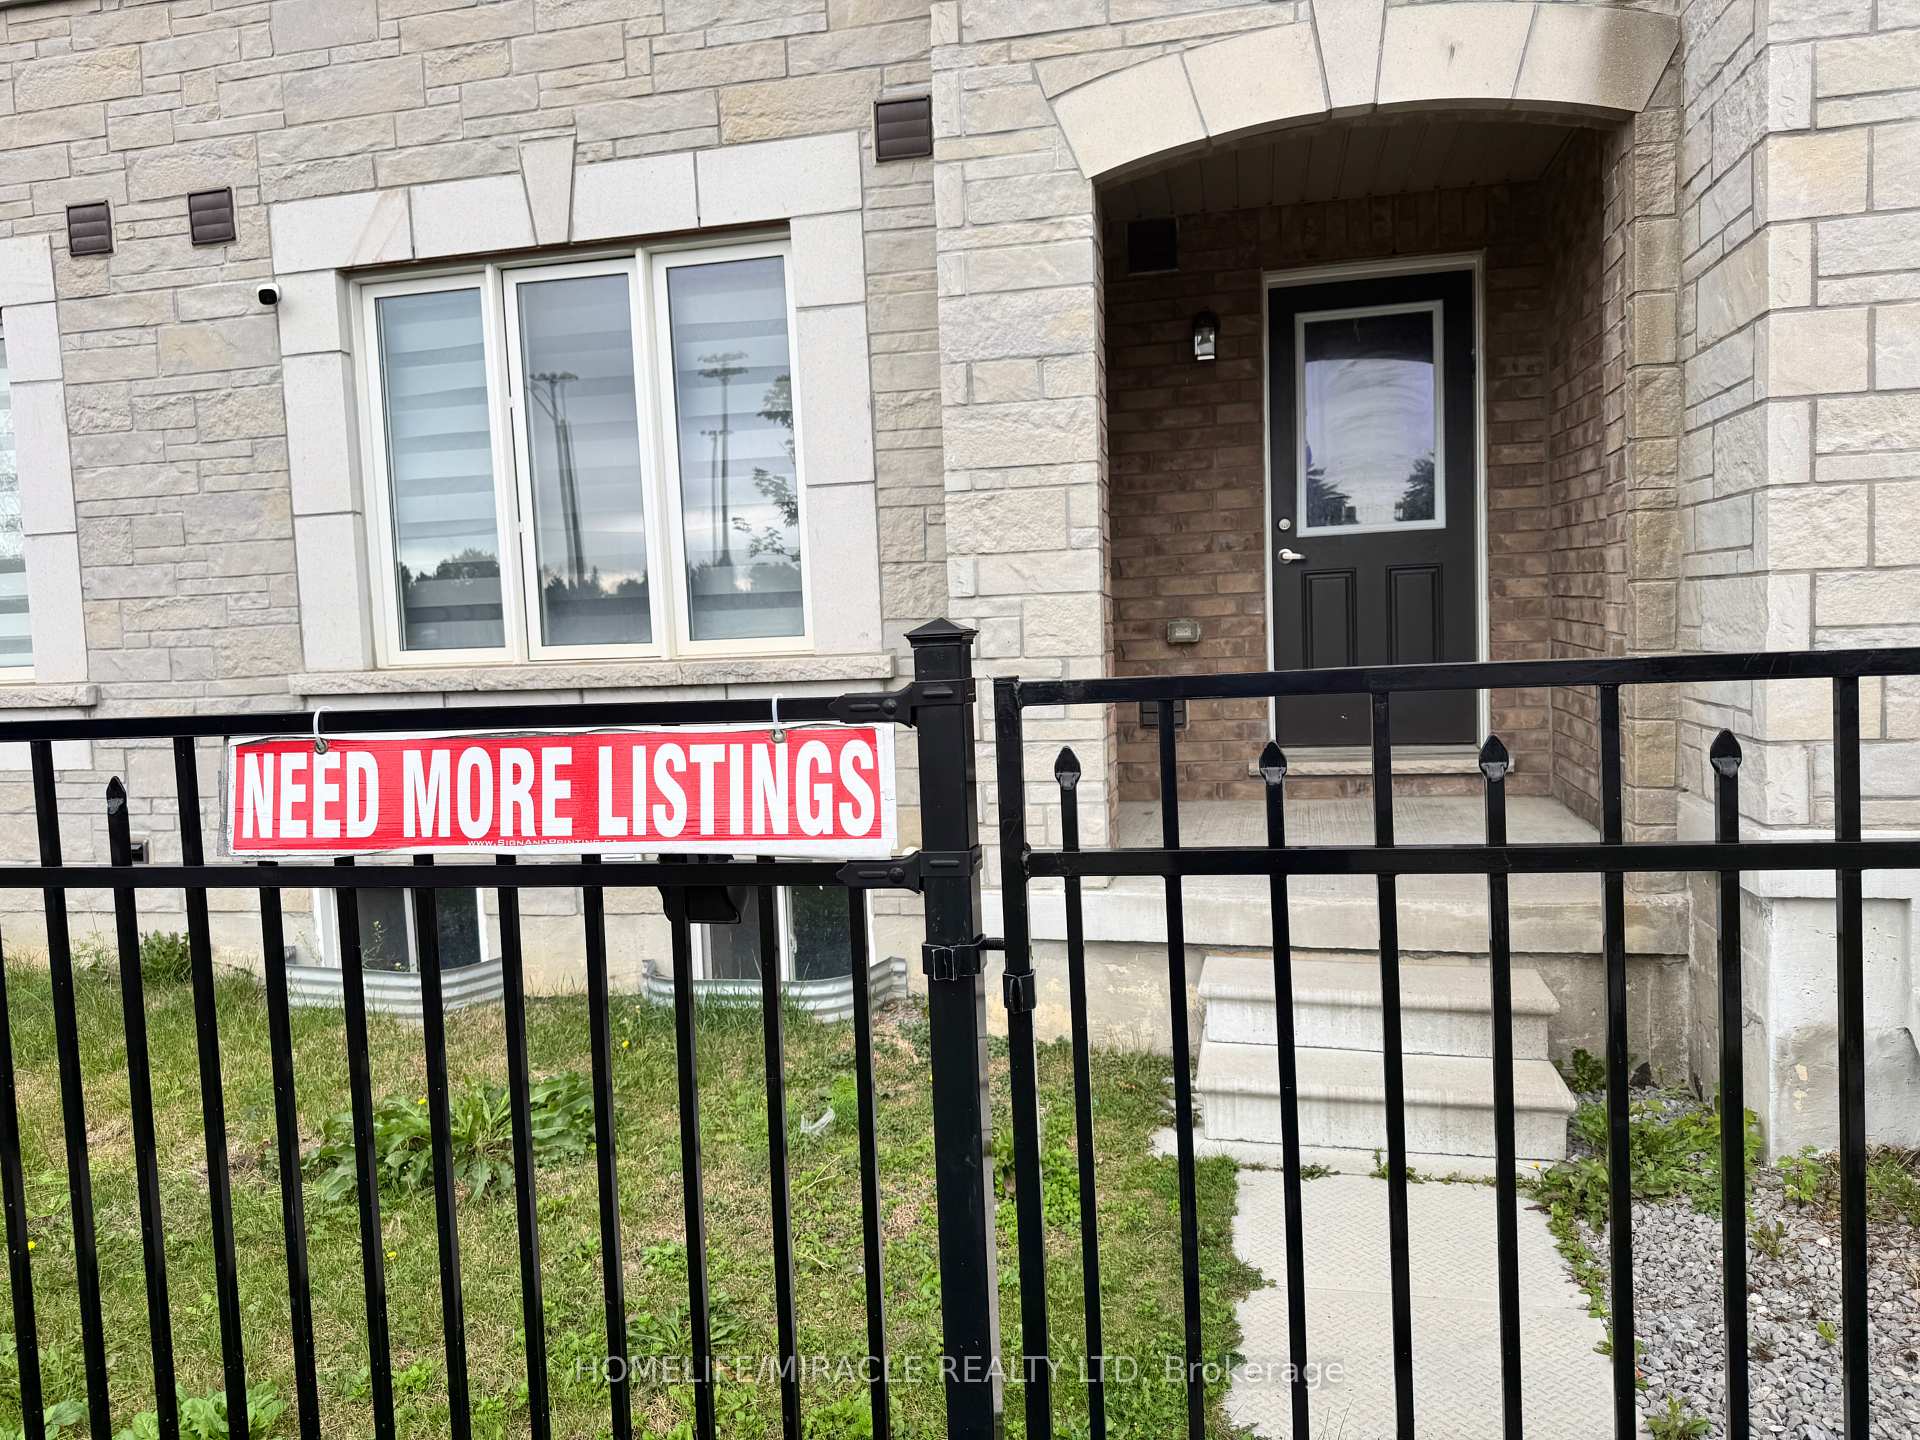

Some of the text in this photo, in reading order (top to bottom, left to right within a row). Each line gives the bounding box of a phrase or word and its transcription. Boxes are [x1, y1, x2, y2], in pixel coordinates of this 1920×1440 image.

[242, 739, 875, 838] NEED MORE LISTINGS
